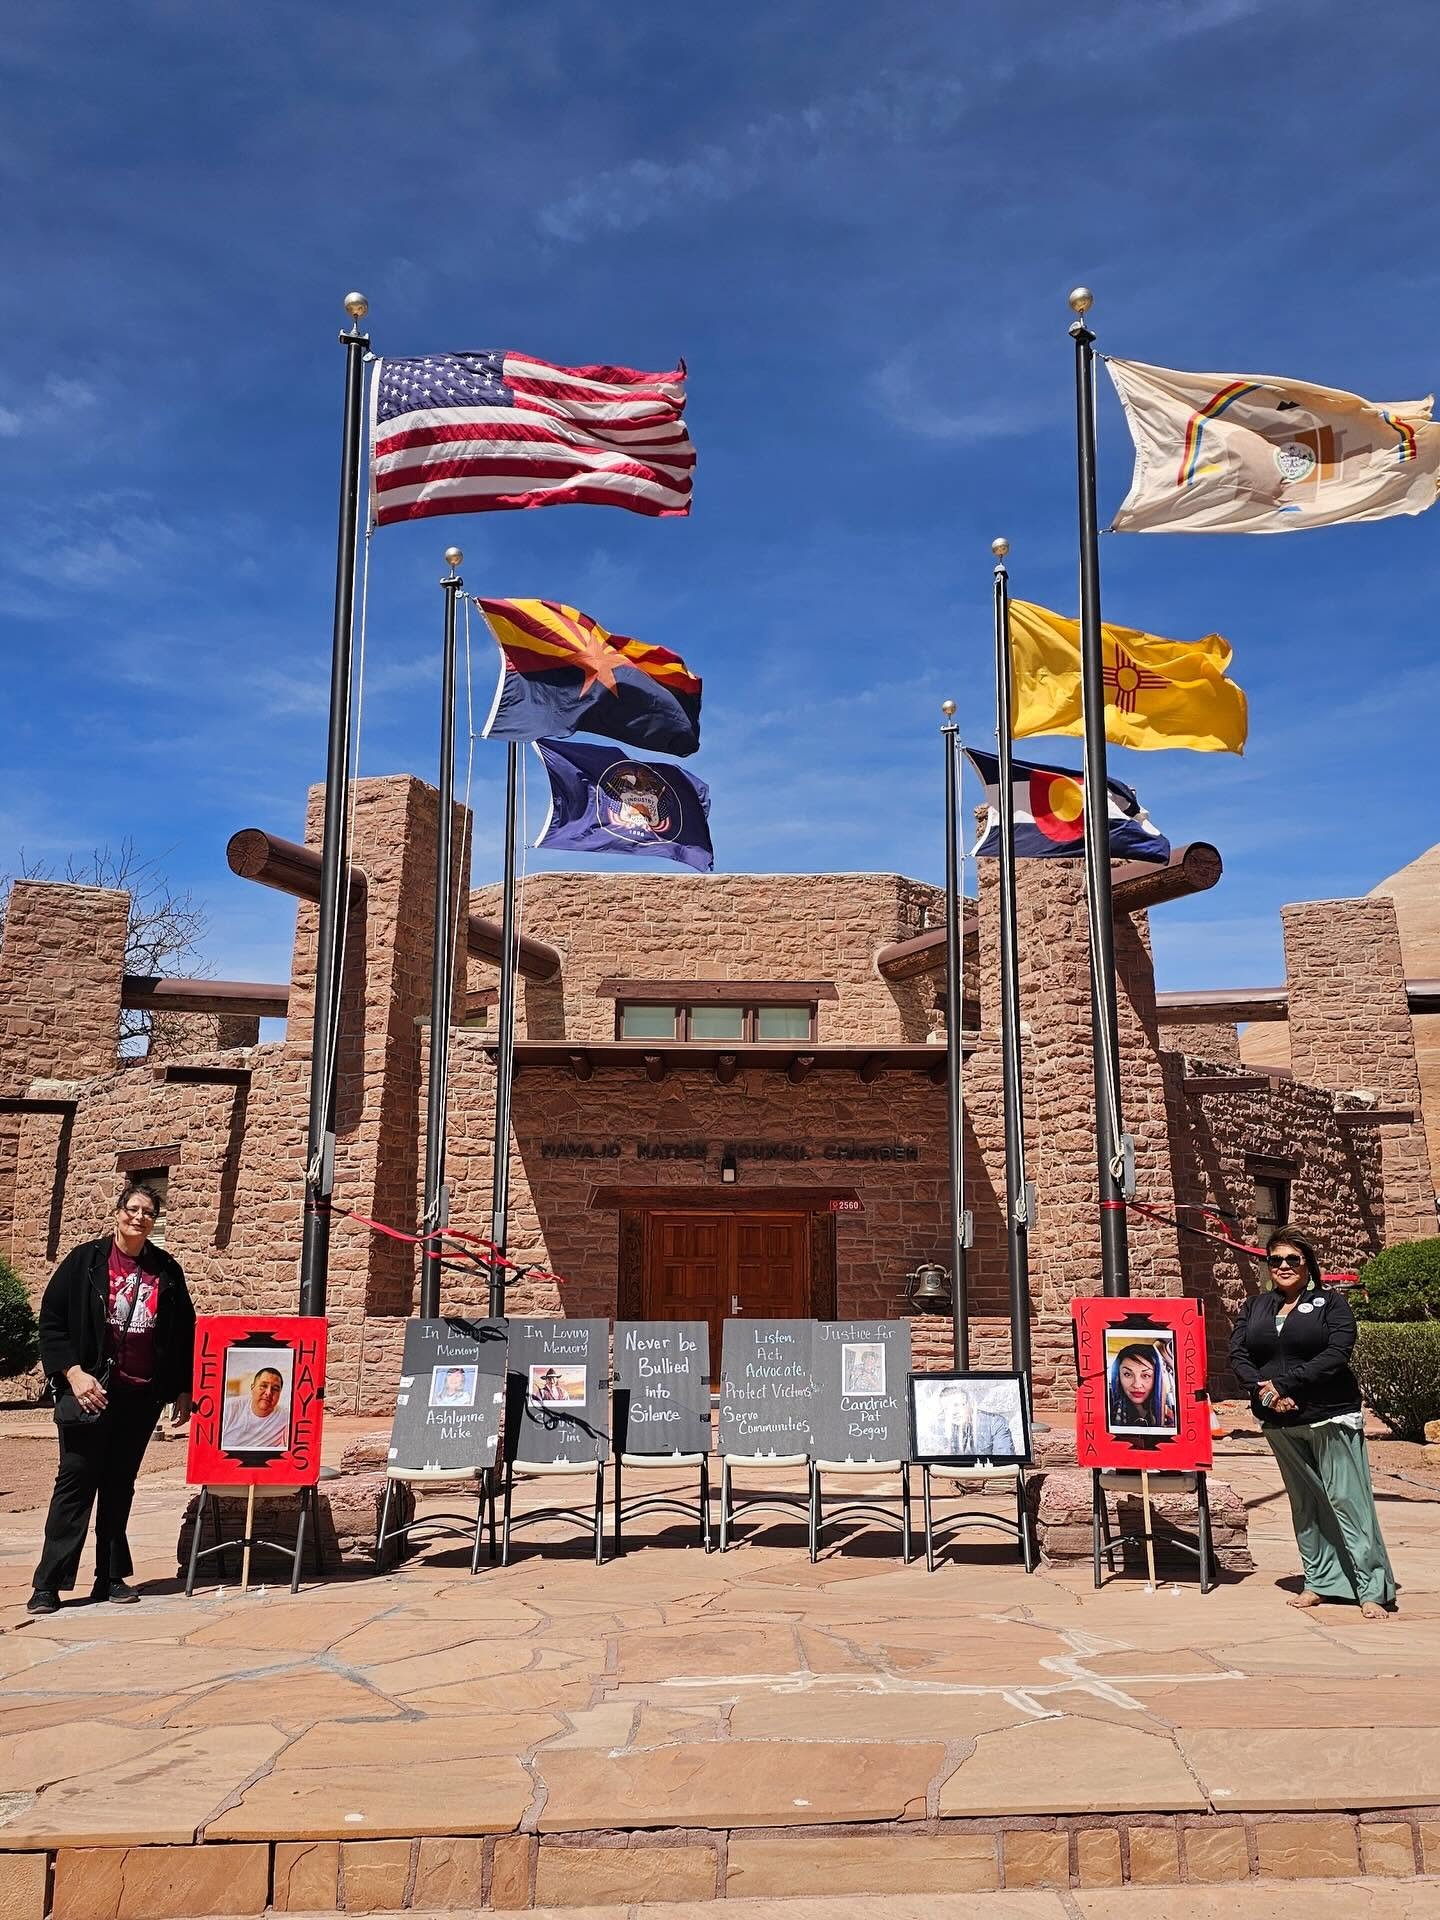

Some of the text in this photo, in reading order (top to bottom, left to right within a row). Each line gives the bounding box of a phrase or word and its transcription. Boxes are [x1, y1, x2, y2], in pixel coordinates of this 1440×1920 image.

[627, 797, 655, 805] INDUSTRY
[839, 1201, 859, 1210] 2560
[422, 1325, 440, 1340] In
[524, 1324, 589, 1345] In Loving
[625, 1330, 698, 1352] Never be
[820, 1324, 897, 1341] Justice for
[437, 1344, 479, 1361] Memory
[543, 1341, 588, 1358] Memory
[639, 1356, 690, 1377] Bullied
[1181, 1308, 1197, 1442] CARRILLO
[195, 1331, 217, 1446] LEON
[1079, 1305, 1098, 1456] KRISTINA
[645, 1383, 671, 1399] into
[725, 1381, 768, 1399] Protect
[291, 1340, 317, 1470] HAYES
[840, 1397, 898, 1411] Candrick
[426, 1410, 485, 1428] Ashlynne
[630, 1403, 681, 1423] Silence
[860, 1411, 882, 1422] Pat
[440, 1427, 472, 1439] Mike
[738, 1416, 810, 1435] Communities
[848, 1423, 888, 1440] Begay
[558, 1430, 582, 1443] Jim
